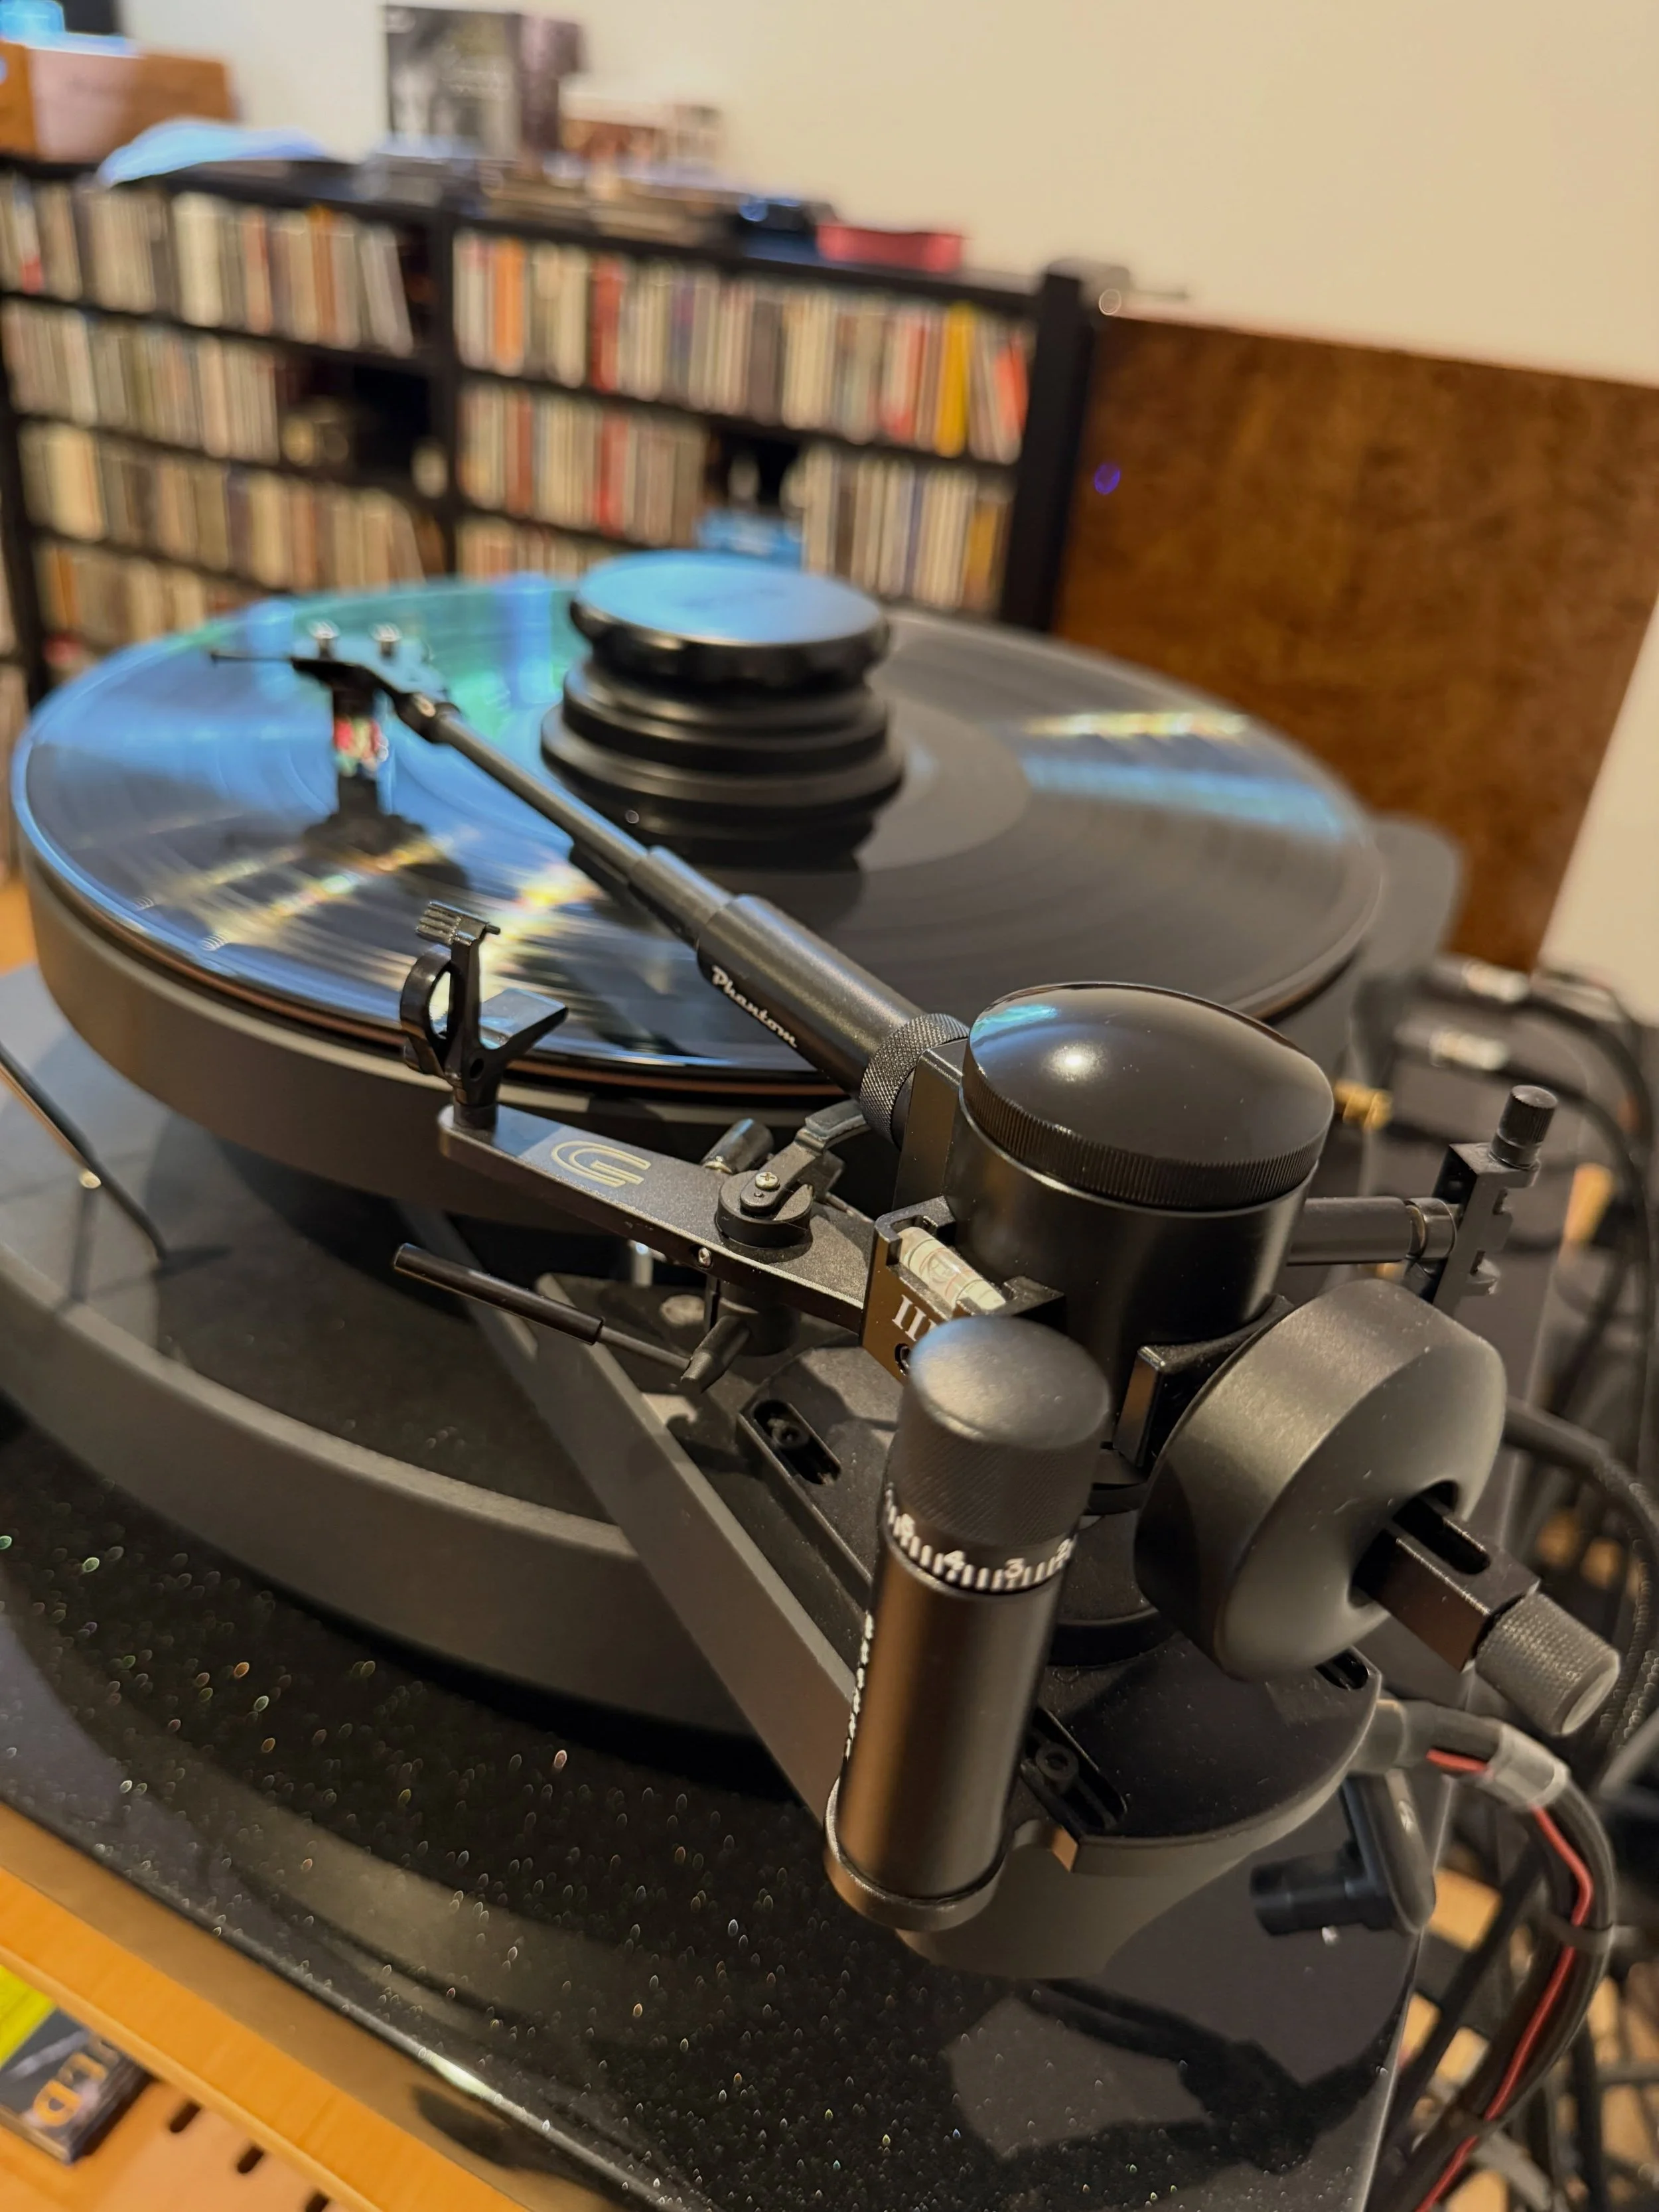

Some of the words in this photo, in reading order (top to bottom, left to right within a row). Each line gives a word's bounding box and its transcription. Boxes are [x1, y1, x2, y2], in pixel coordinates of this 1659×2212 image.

[711, 964, 798, 1049] Phantom
[891, 1293, 938, 1342] II
[1005, 1558, 1025, 1579] 3
